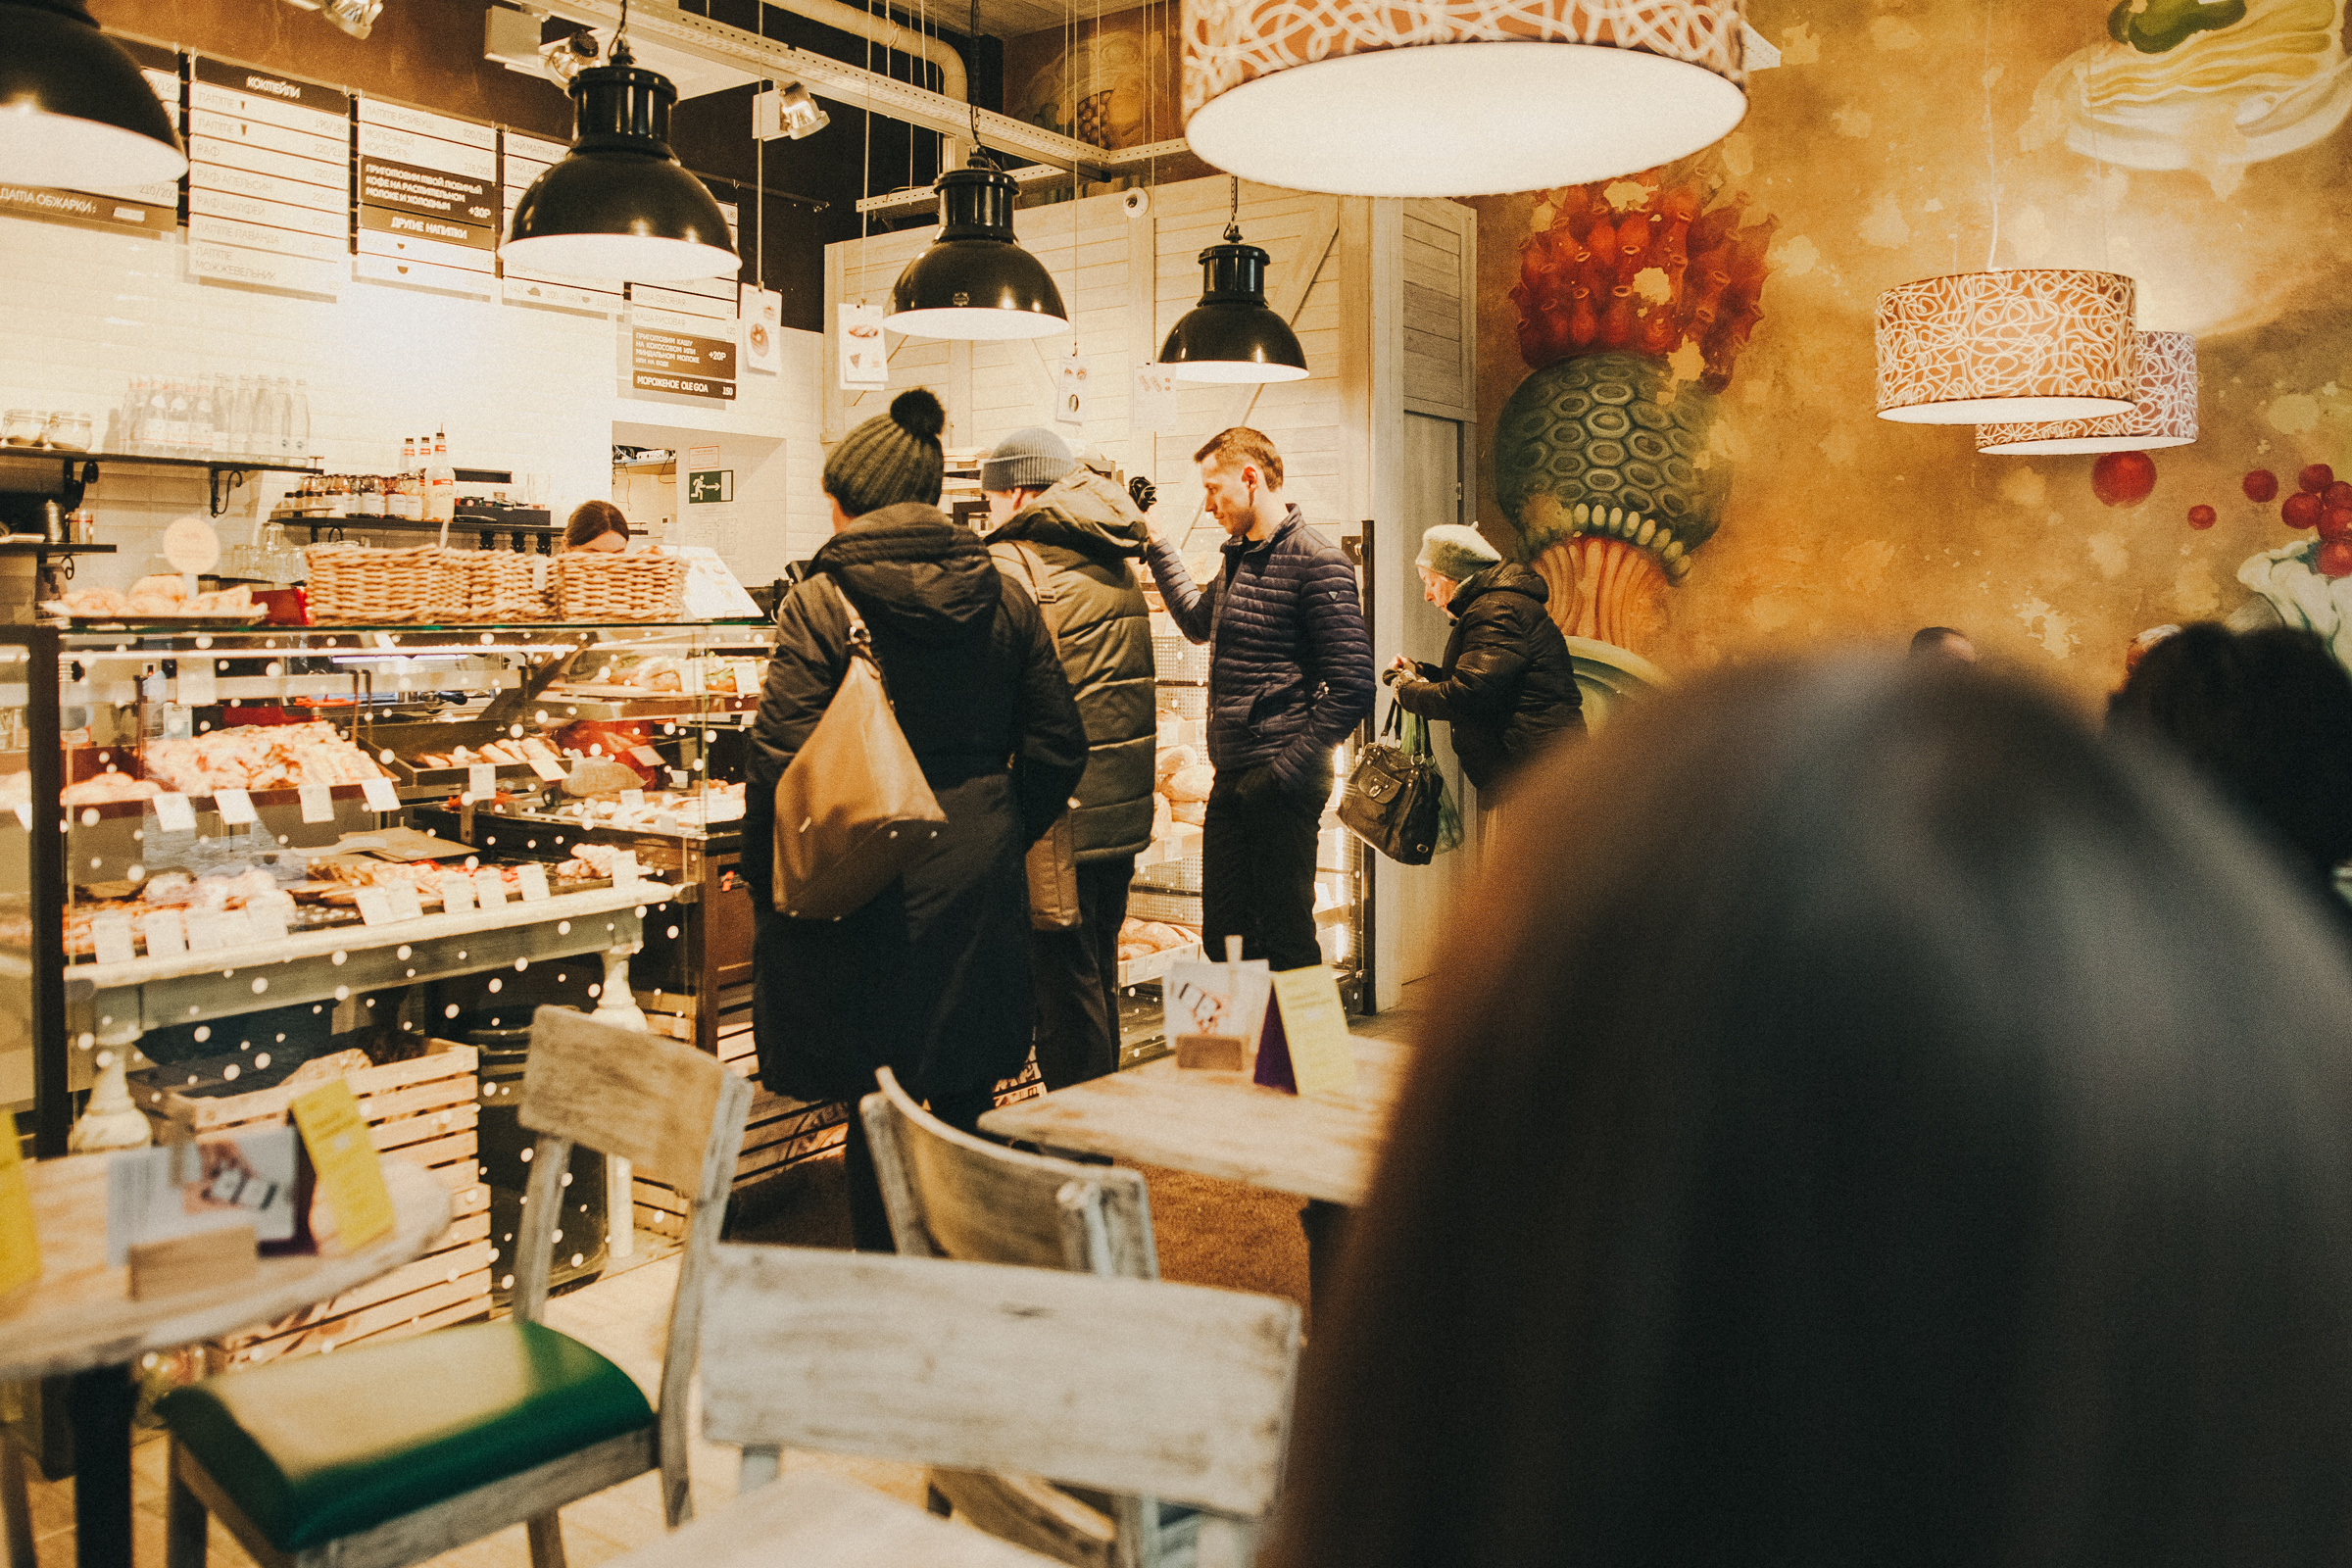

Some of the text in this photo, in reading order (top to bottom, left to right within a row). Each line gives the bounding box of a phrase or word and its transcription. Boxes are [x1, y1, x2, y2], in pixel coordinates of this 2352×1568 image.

[246, 75, 301, 99] КОКТЕЙЛИ
[198, 92, 235, 108] ЛАТТЕ
[198, 118, 235, 134] ЛАТТЕ
[197, 144, 220, 157] РАФ
[196, 170, 273, 192] РАФ АПЕЛЬСИН
[366, 164, 421, 181] ПРИГОТОВИМ
[421, 172, 445, 186] ТВОЙ
[366, 175, 466, 203] КОФЕ НА РАСТИТЕЛЬНОМ
[366, 187, 400, 202] МОЛОКЕ
[196, 195, 266, 216] РАФ ШАЛФЕЙ
[196, 221, 280, 244] ЛАТТЕ ЛАВАНДА
[390, 216, 467, 240] ДРУГИЕ НАПИТКИ
[195, 246, 232, 260] ЛАТТЕ
[195, 260, 276, 281] МОЖЖЕВЕЛЬНИК
[635, 291, 655, 301] КАША
[635, 312, 655, 321] КАША
[636, 375, 680, 390] МОРОЖЕНОЕ
